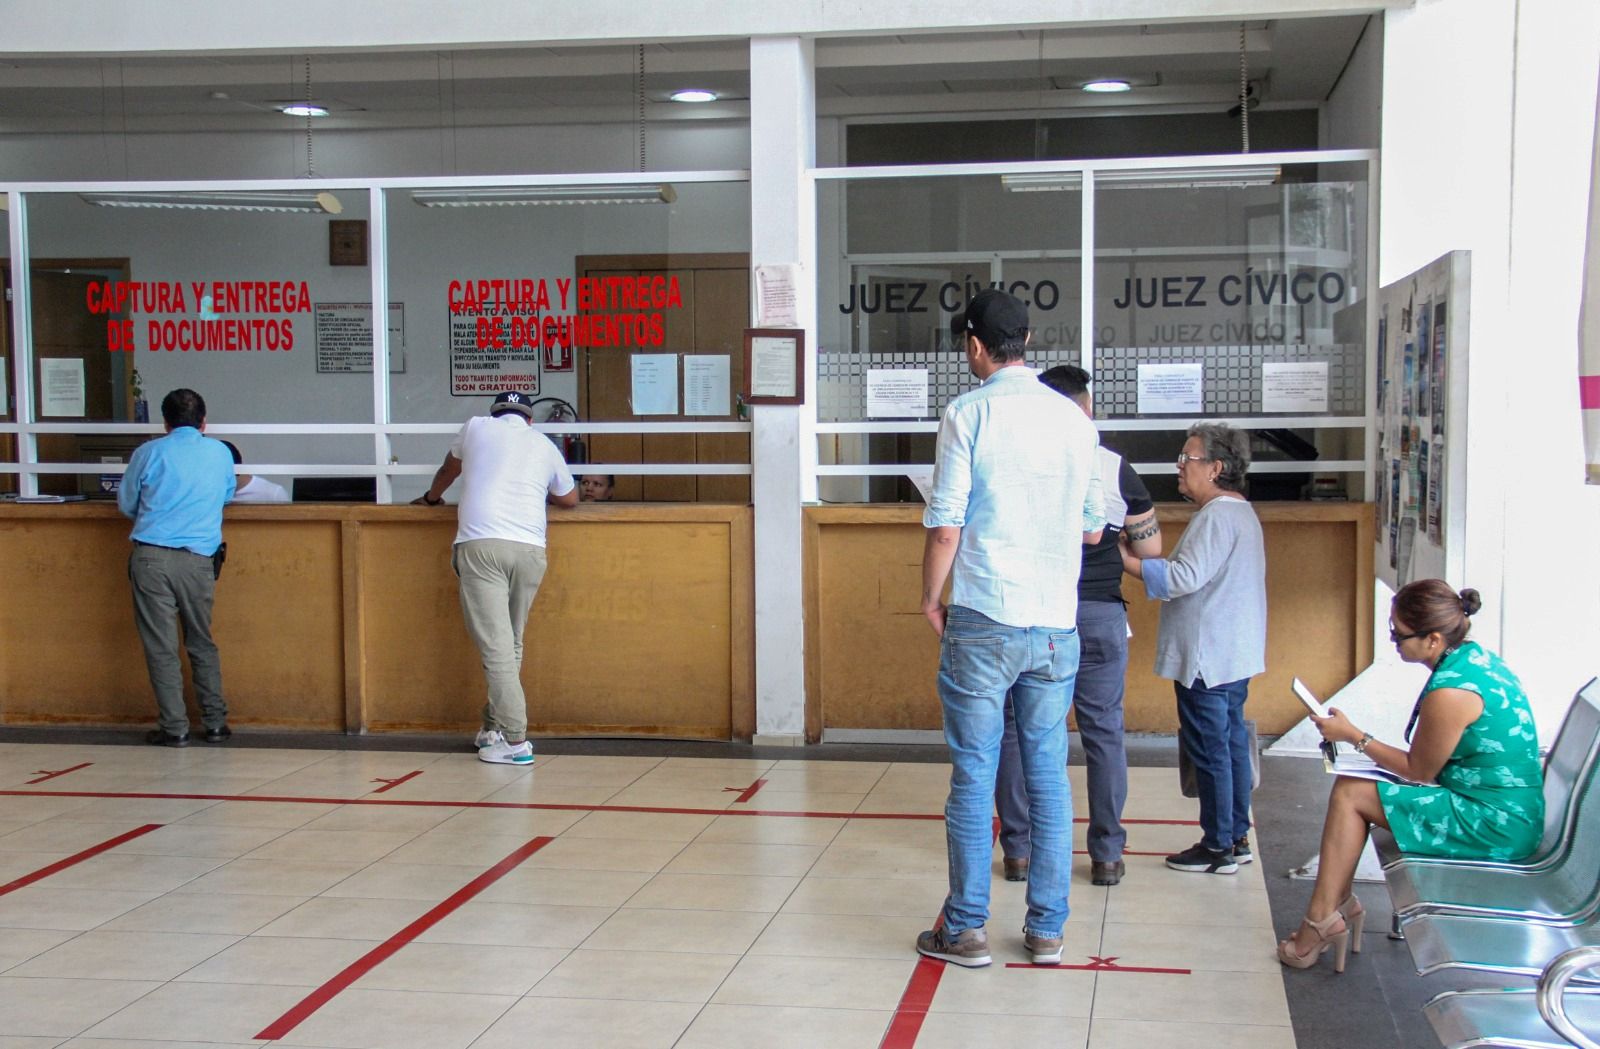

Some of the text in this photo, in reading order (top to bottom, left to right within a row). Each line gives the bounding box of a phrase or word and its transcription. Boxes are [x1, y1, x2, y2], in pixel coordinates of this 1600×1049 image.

[87, 281, 311, 314] CAPTURA Y ENTREGA
[448, 275, 683, 313] CAPTURA Y ENTREGA
[839, 282, 928, 315] JUEZ
[1113, 266, 1346, 310] JUEZ CÍVICO
[107, 318, 294, 353] DE DOCUMENTOS
[476, 312, 665, 350] DE DOCUMENTOS
[455, 383, 536, 391] SON GRATUITOS
